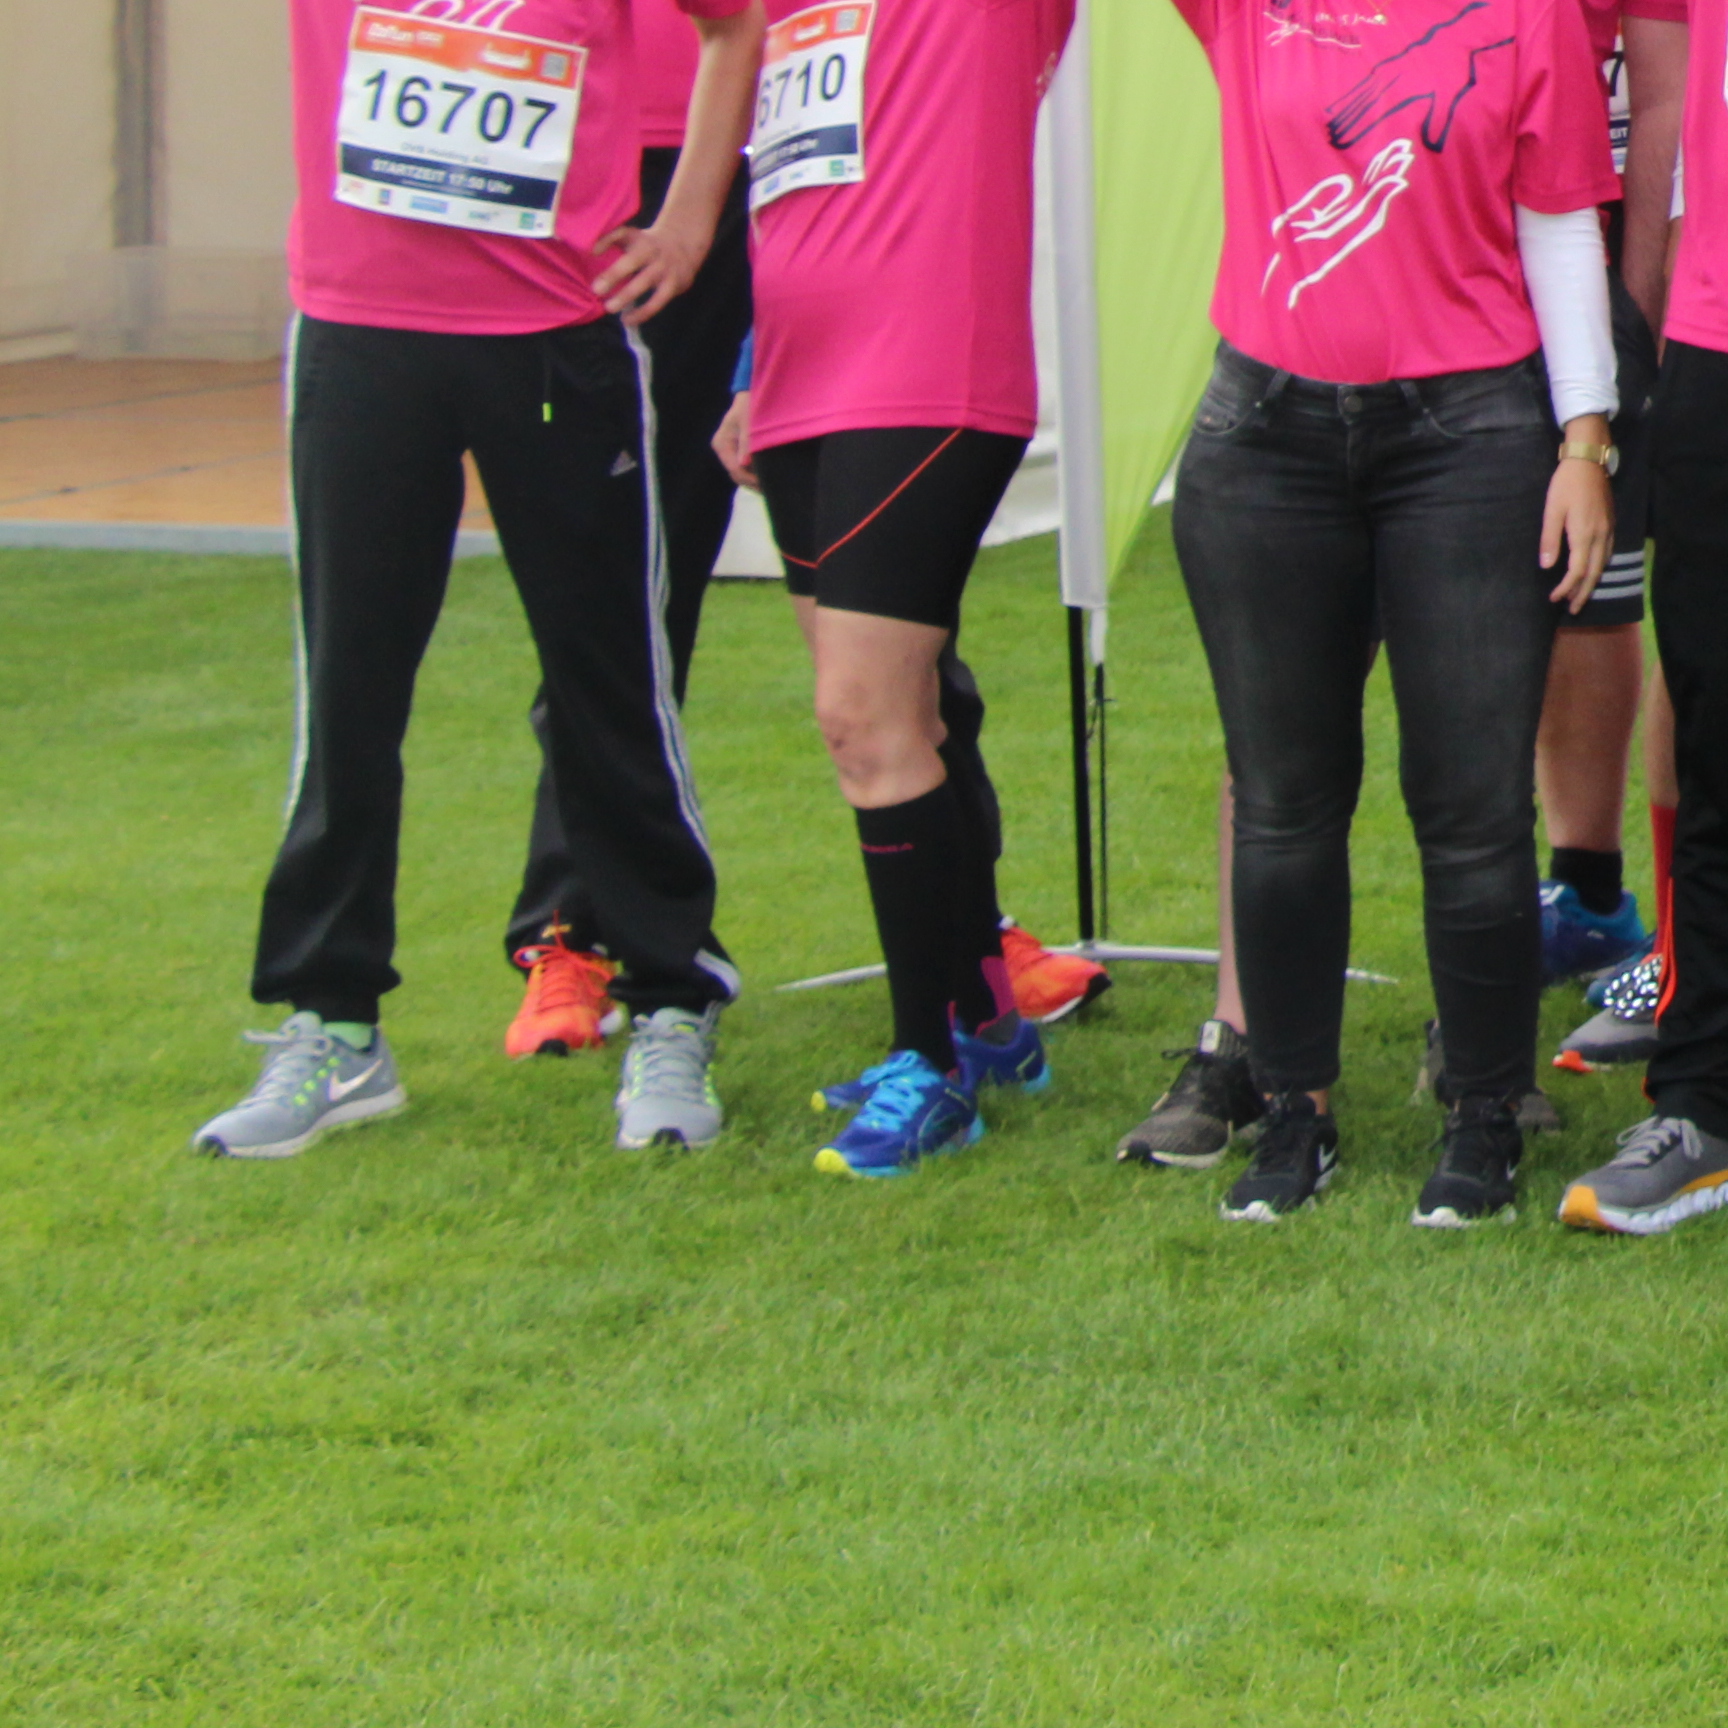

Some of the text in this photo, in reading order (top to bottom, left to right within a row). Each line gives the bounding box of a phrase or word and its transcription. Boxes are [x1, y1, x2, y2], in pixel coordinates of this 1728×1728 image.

[364, 69, 558, 149] 16707
[757, 53, 846, 129] 6710
[372, 158, 447, 183] STARTZEIT
[487, 178, 514, 194] Uhr
